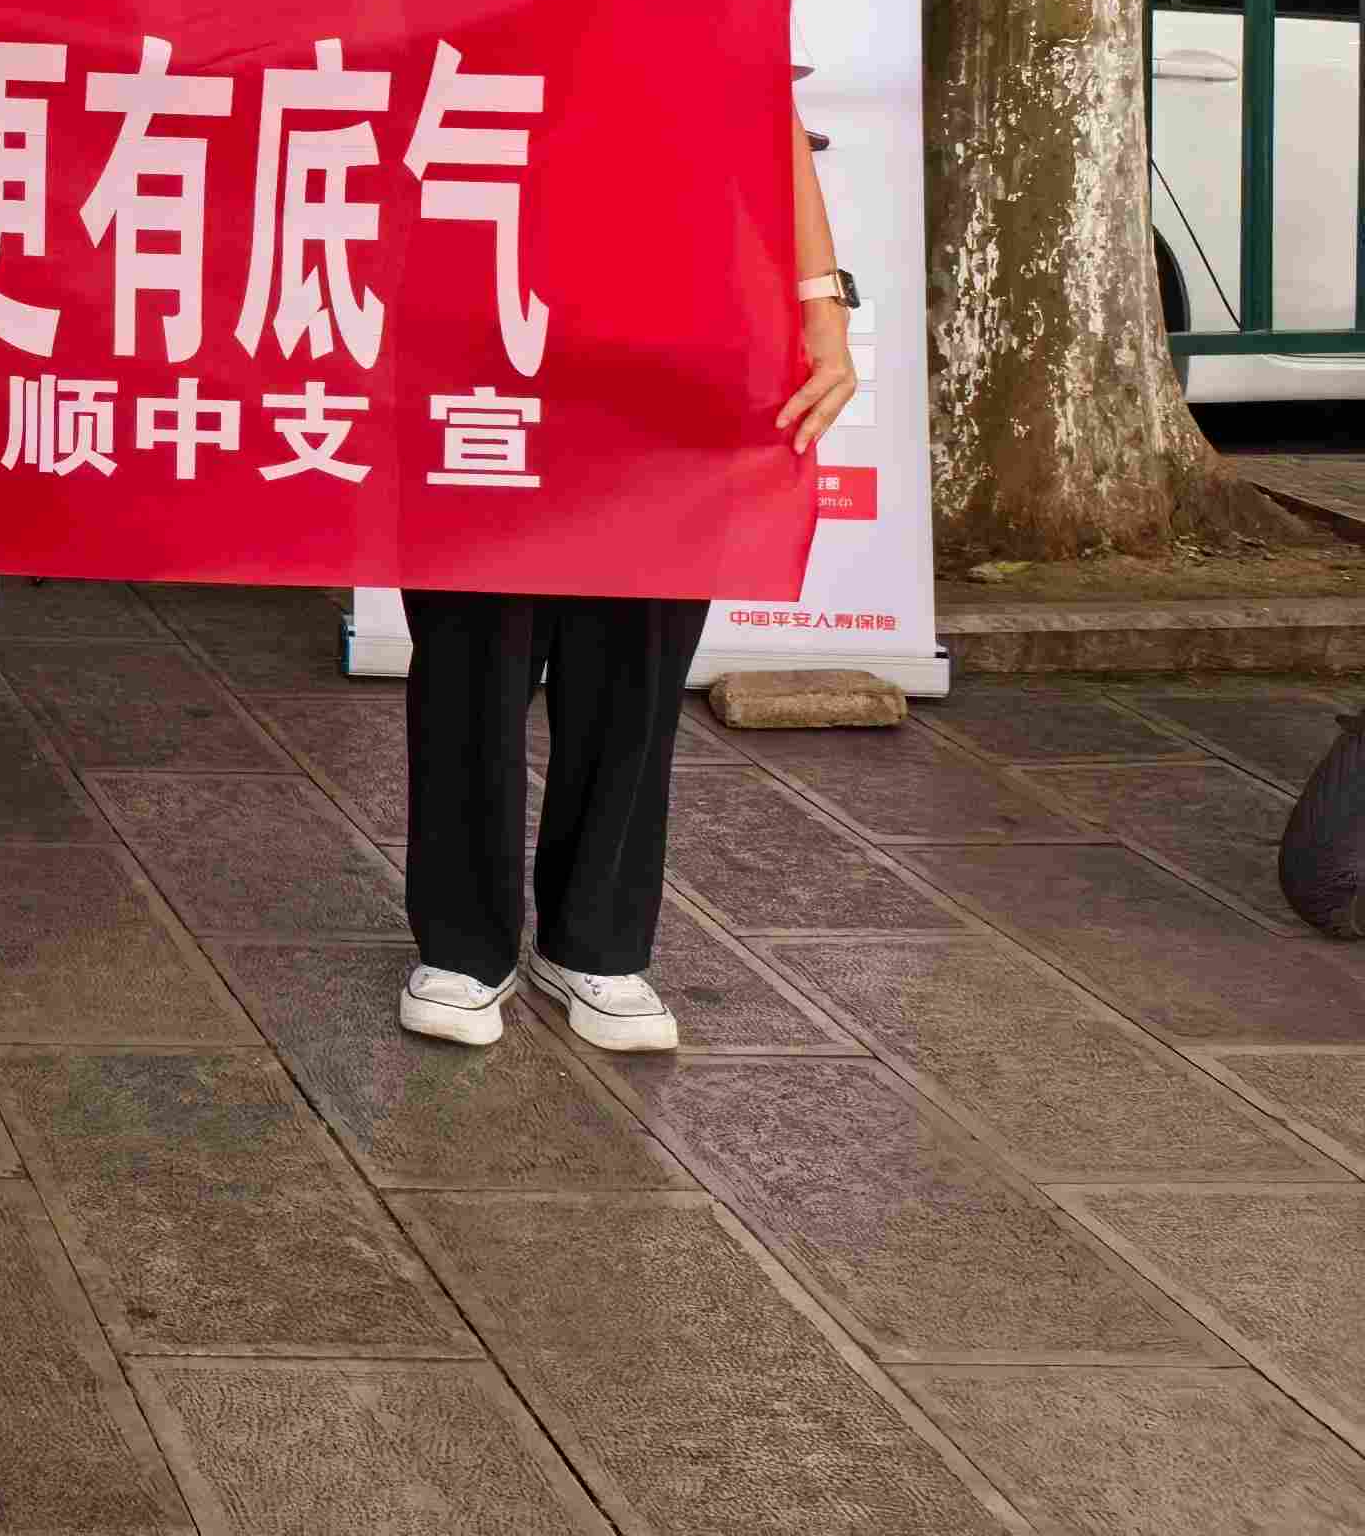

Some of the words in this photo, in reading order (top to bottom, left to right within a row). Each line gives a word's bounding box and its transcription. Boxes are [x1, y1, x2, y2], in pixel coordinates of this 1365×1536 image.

[426, 394, 543, 490] 宣
[729, 610, 897, 632] 中国平安人寿保险
